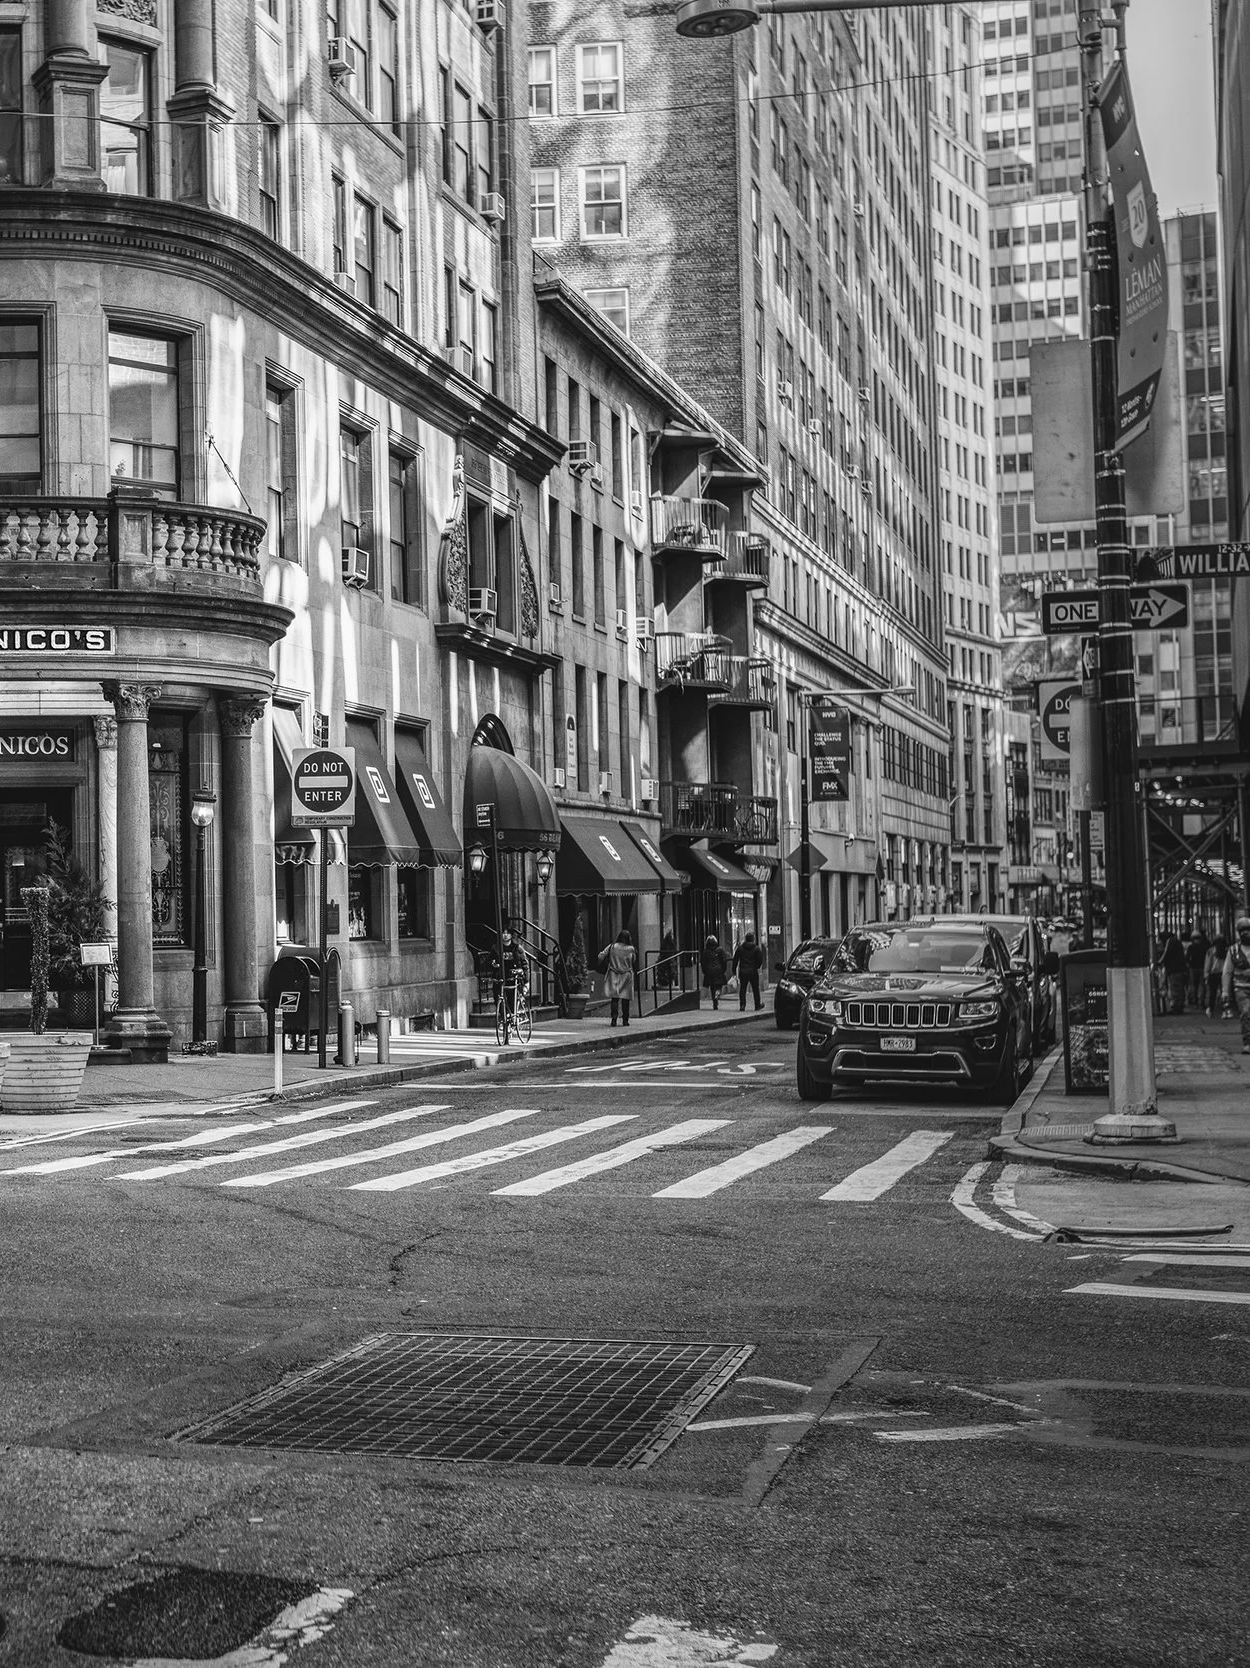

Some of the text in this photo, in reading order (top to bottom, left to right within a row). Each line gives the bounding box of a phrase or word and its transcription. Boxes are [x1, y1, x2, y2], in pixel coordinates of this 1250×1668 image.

[1179, 552, 1250, 574] WILLIA
[1055, 603, 1097, 621] ONE
[303, 762, 344, 773] DO NOT
[304, 791, 343, 802] ENTER
